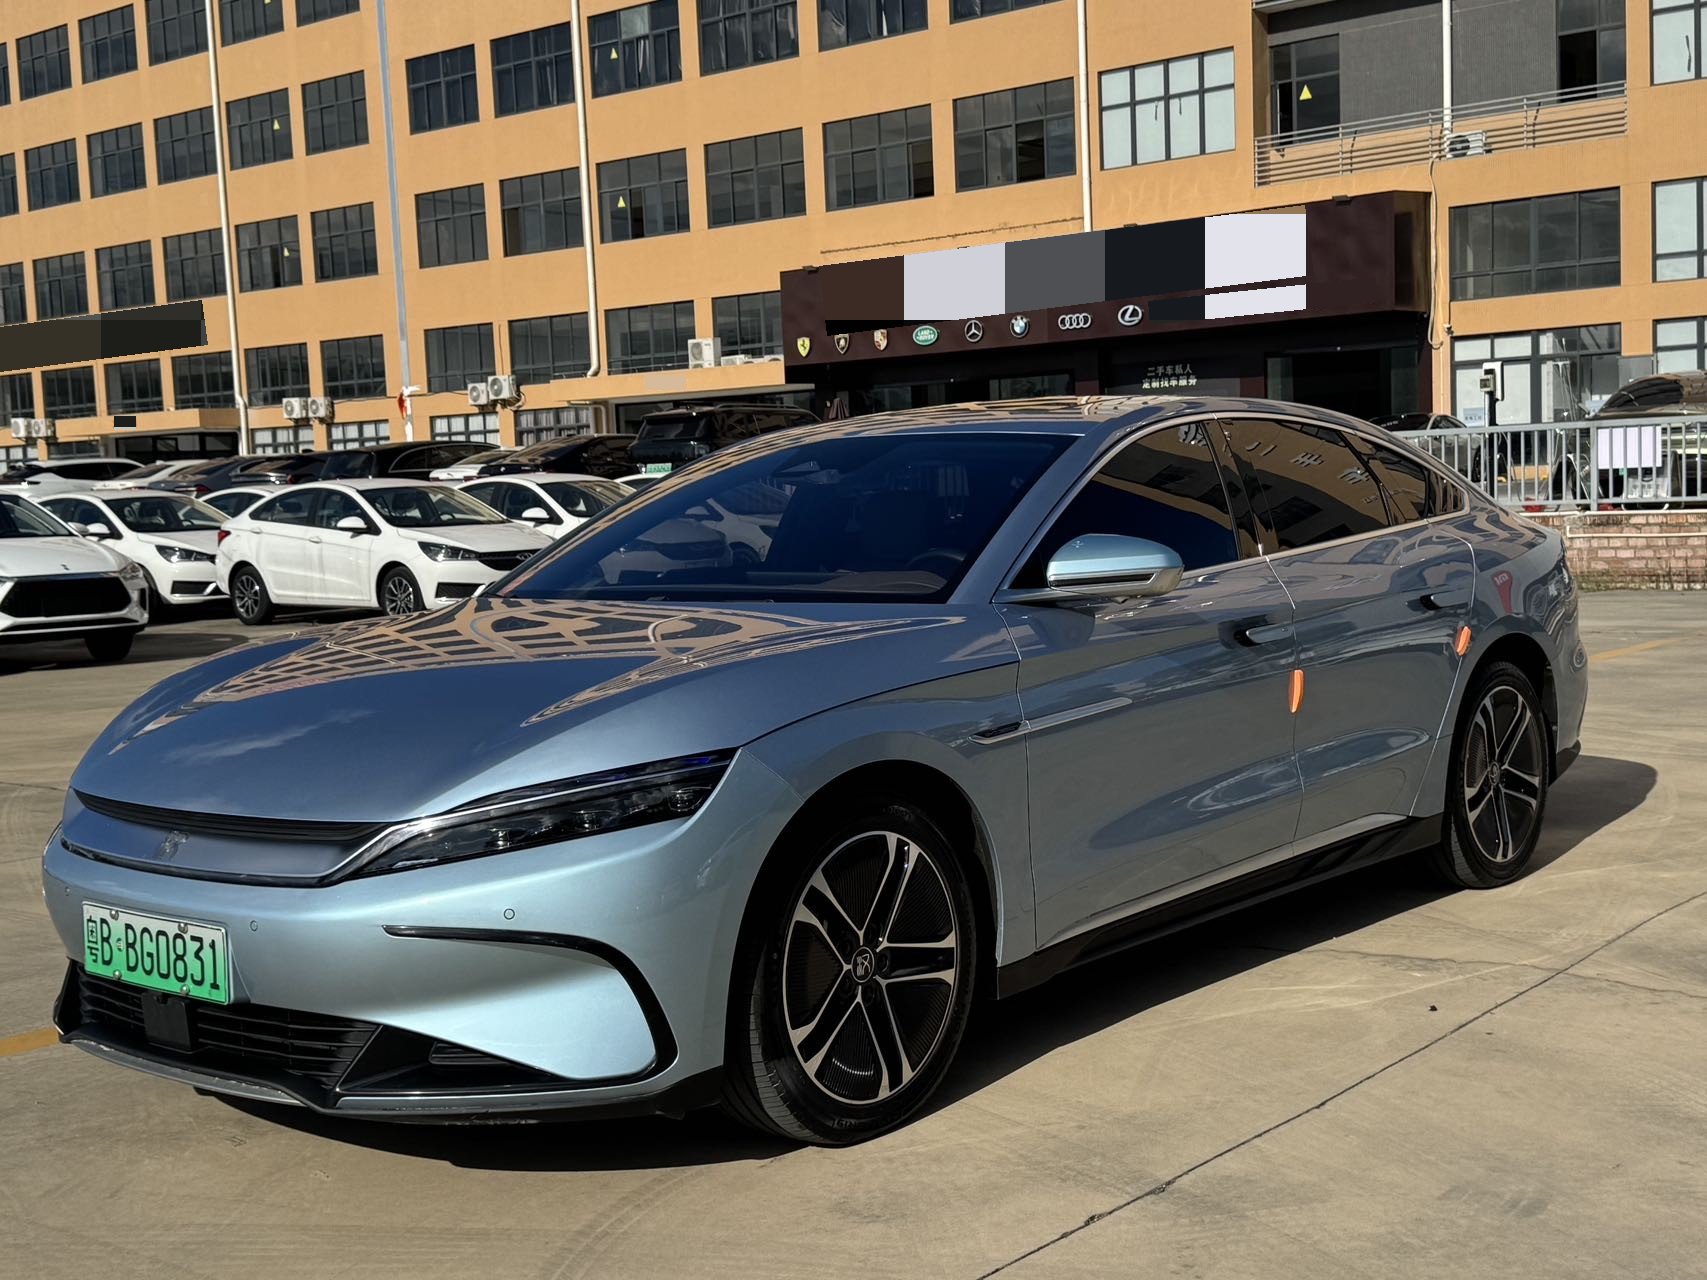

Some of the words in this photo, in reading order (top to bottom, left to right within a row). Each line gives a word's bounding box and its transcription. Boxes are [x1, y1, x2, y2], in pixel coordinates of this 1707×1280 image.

[1147, 363, 1192, 377] 二手车私人
[1142, 375, 1198, 389] 定制找车服务
